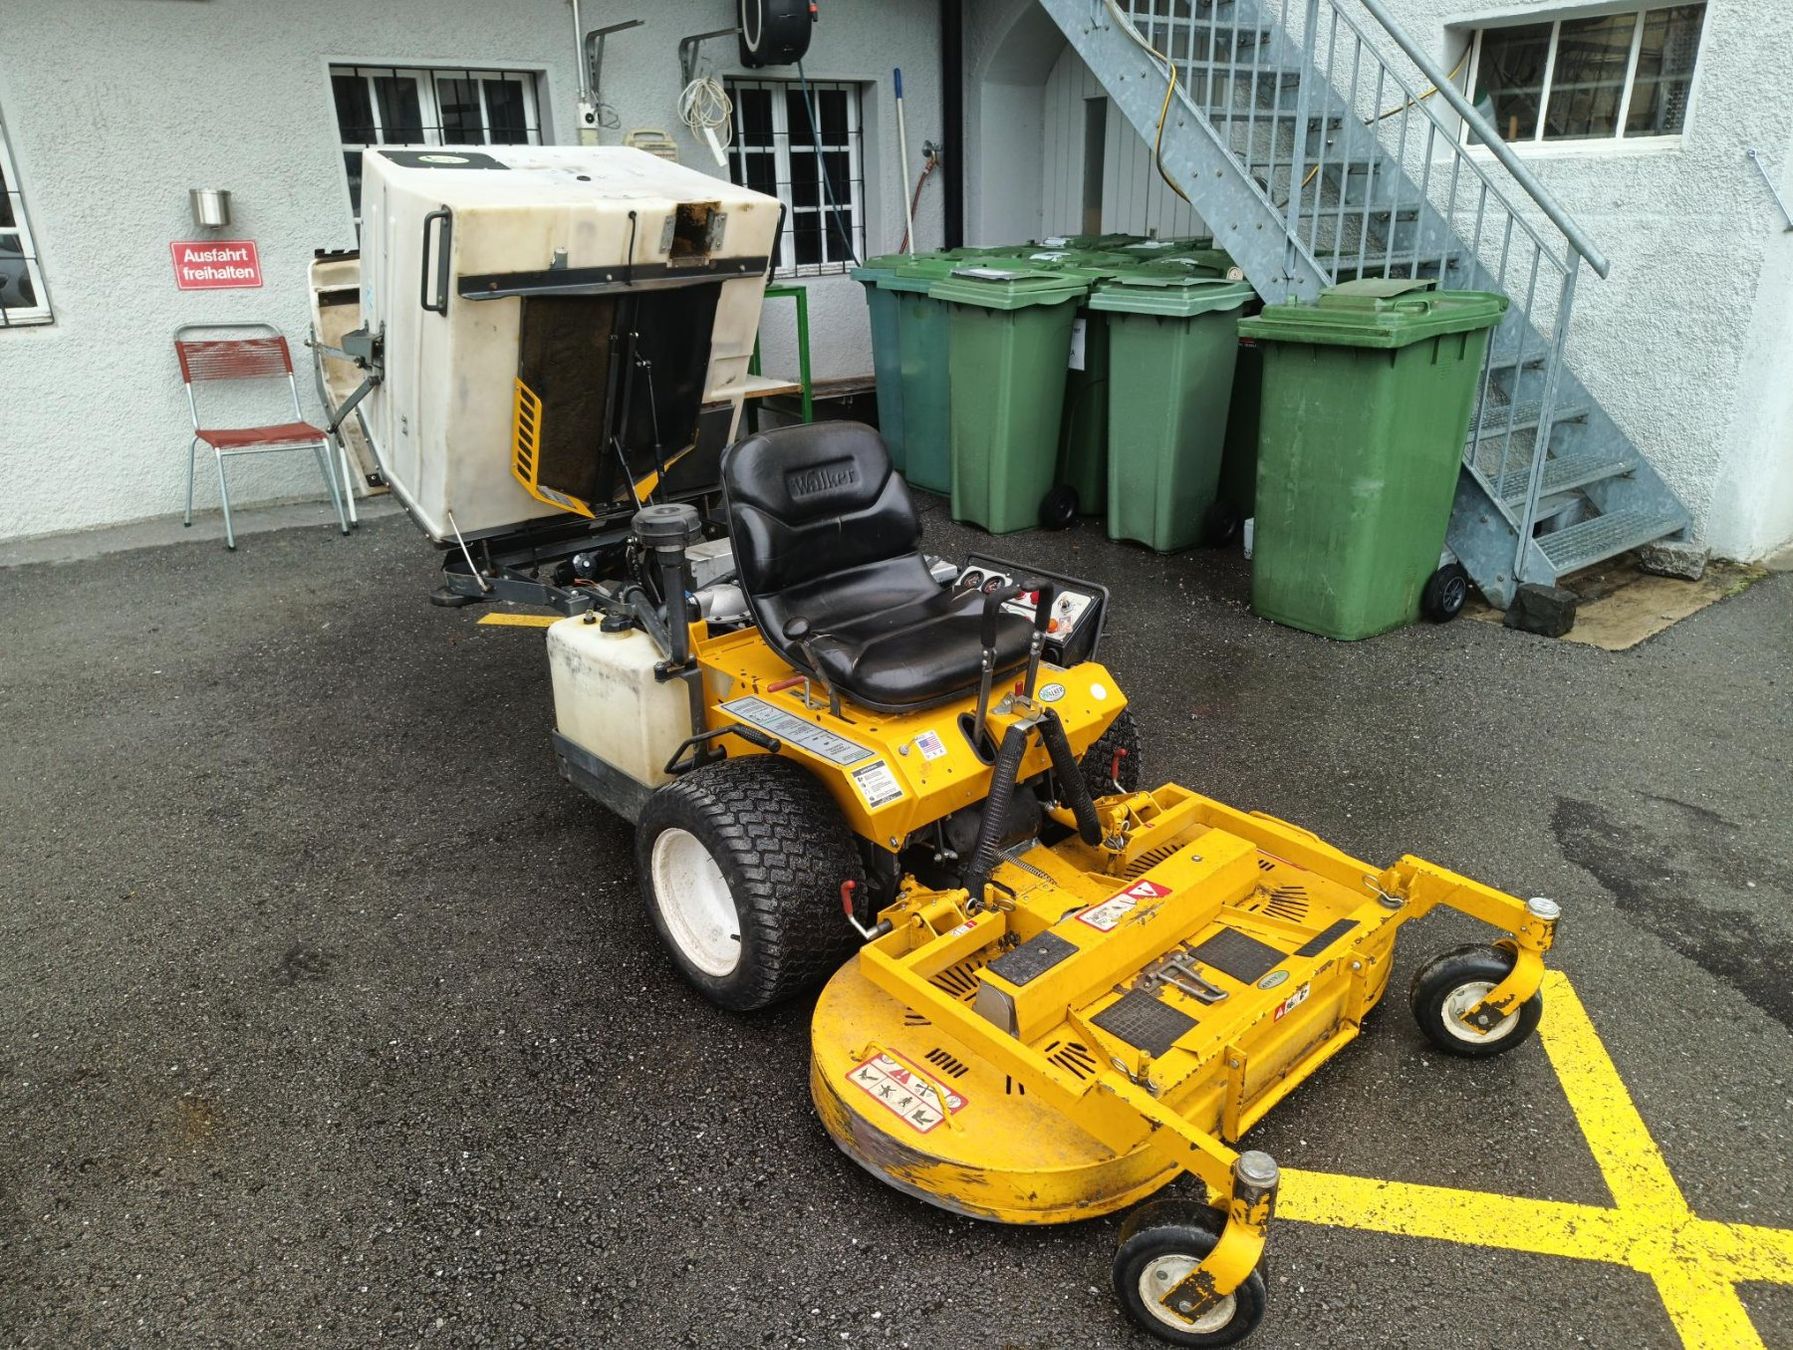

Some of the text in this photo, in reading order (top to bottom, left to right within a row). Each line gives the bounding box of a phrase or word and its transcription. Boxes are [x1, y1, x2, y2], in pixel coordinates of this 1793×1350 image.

[183, 248, 248, 262] Ausfahrt
[183, 265, 254, 280] freihalten
[791, 467, 855, 497] Walker
